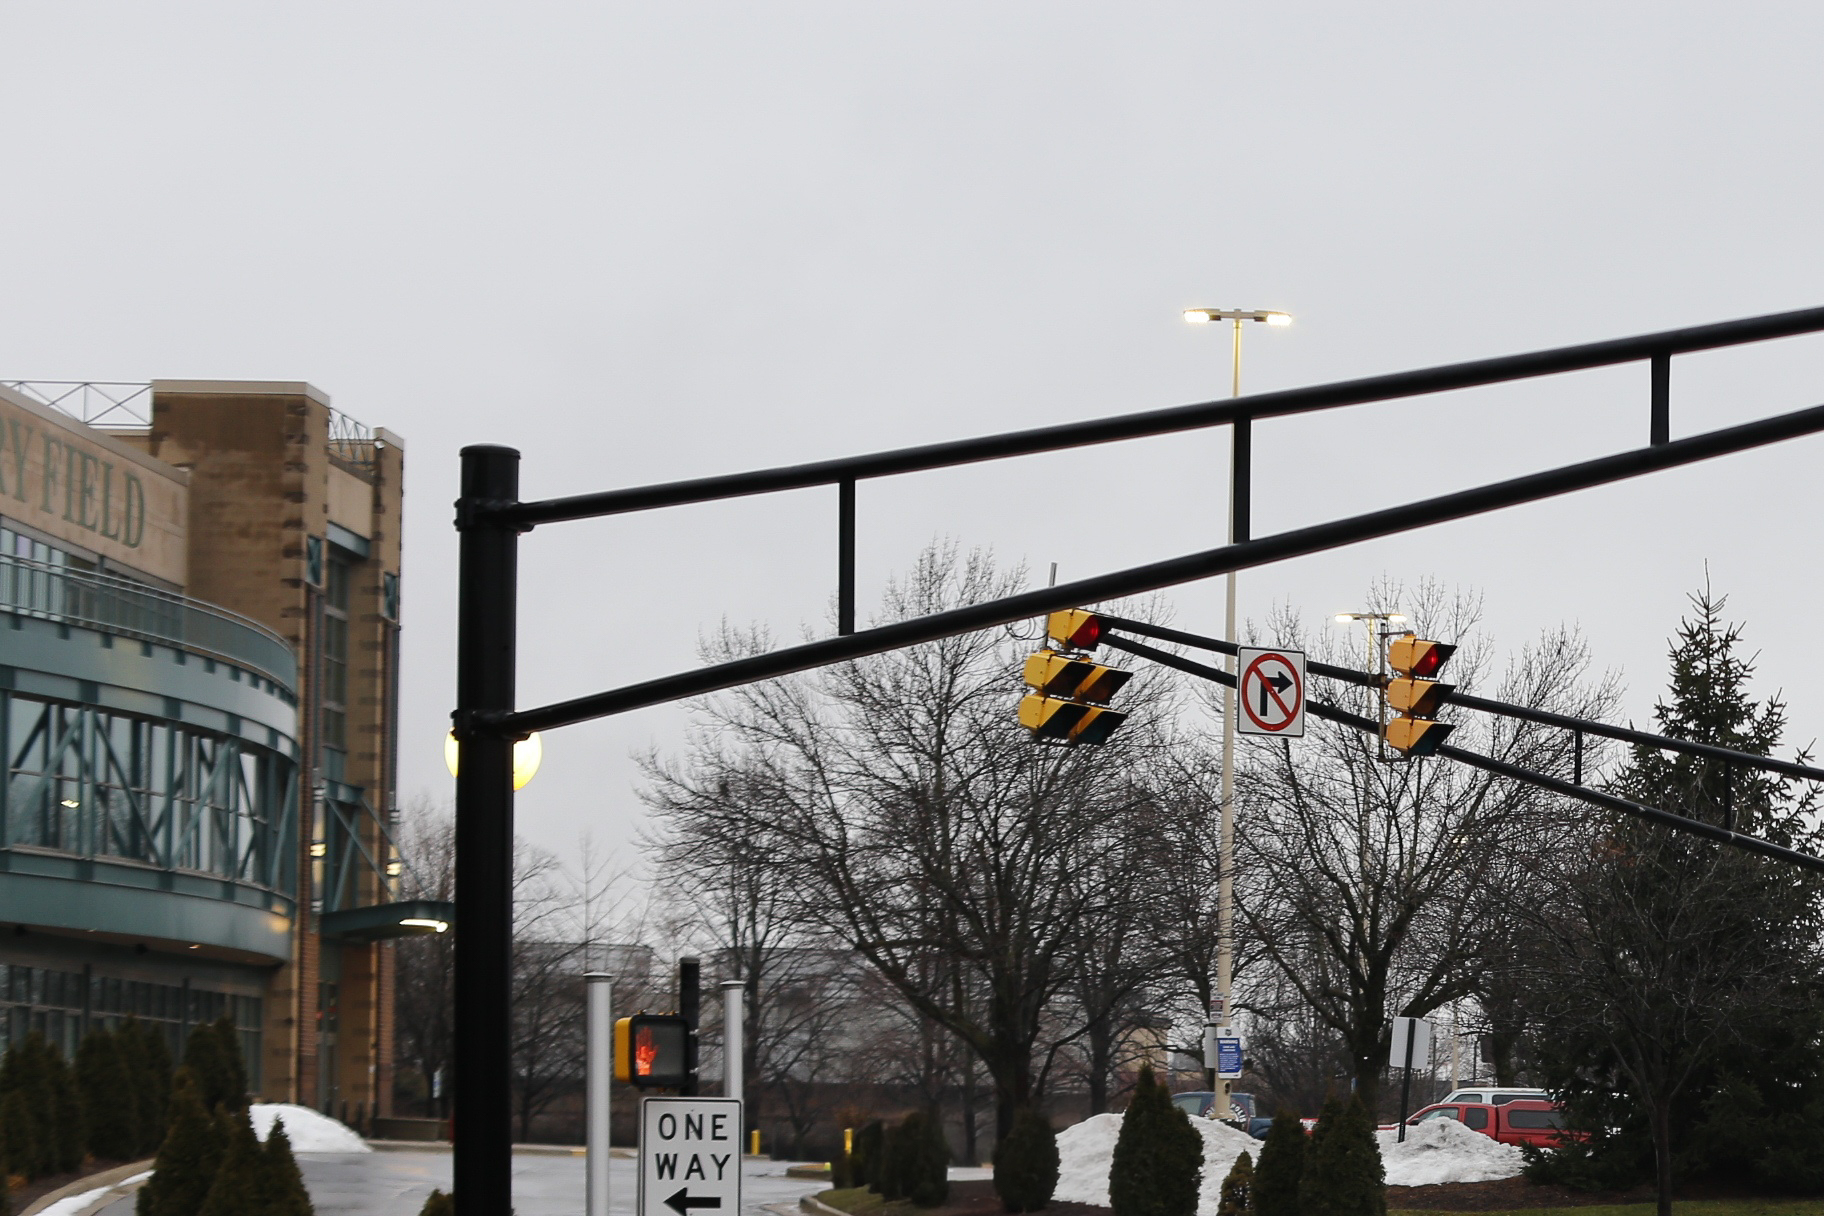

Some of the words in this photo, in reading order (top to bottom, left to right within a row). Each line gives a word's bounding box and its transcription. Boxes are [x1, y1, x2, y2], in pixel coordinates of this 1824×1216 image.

[0, 415, 33, 503] Y
[40, 431, 144, 548] FIELD
[658, 1113, 728, 1141] ONE
[655, 1153, 732, 1181] WAY
